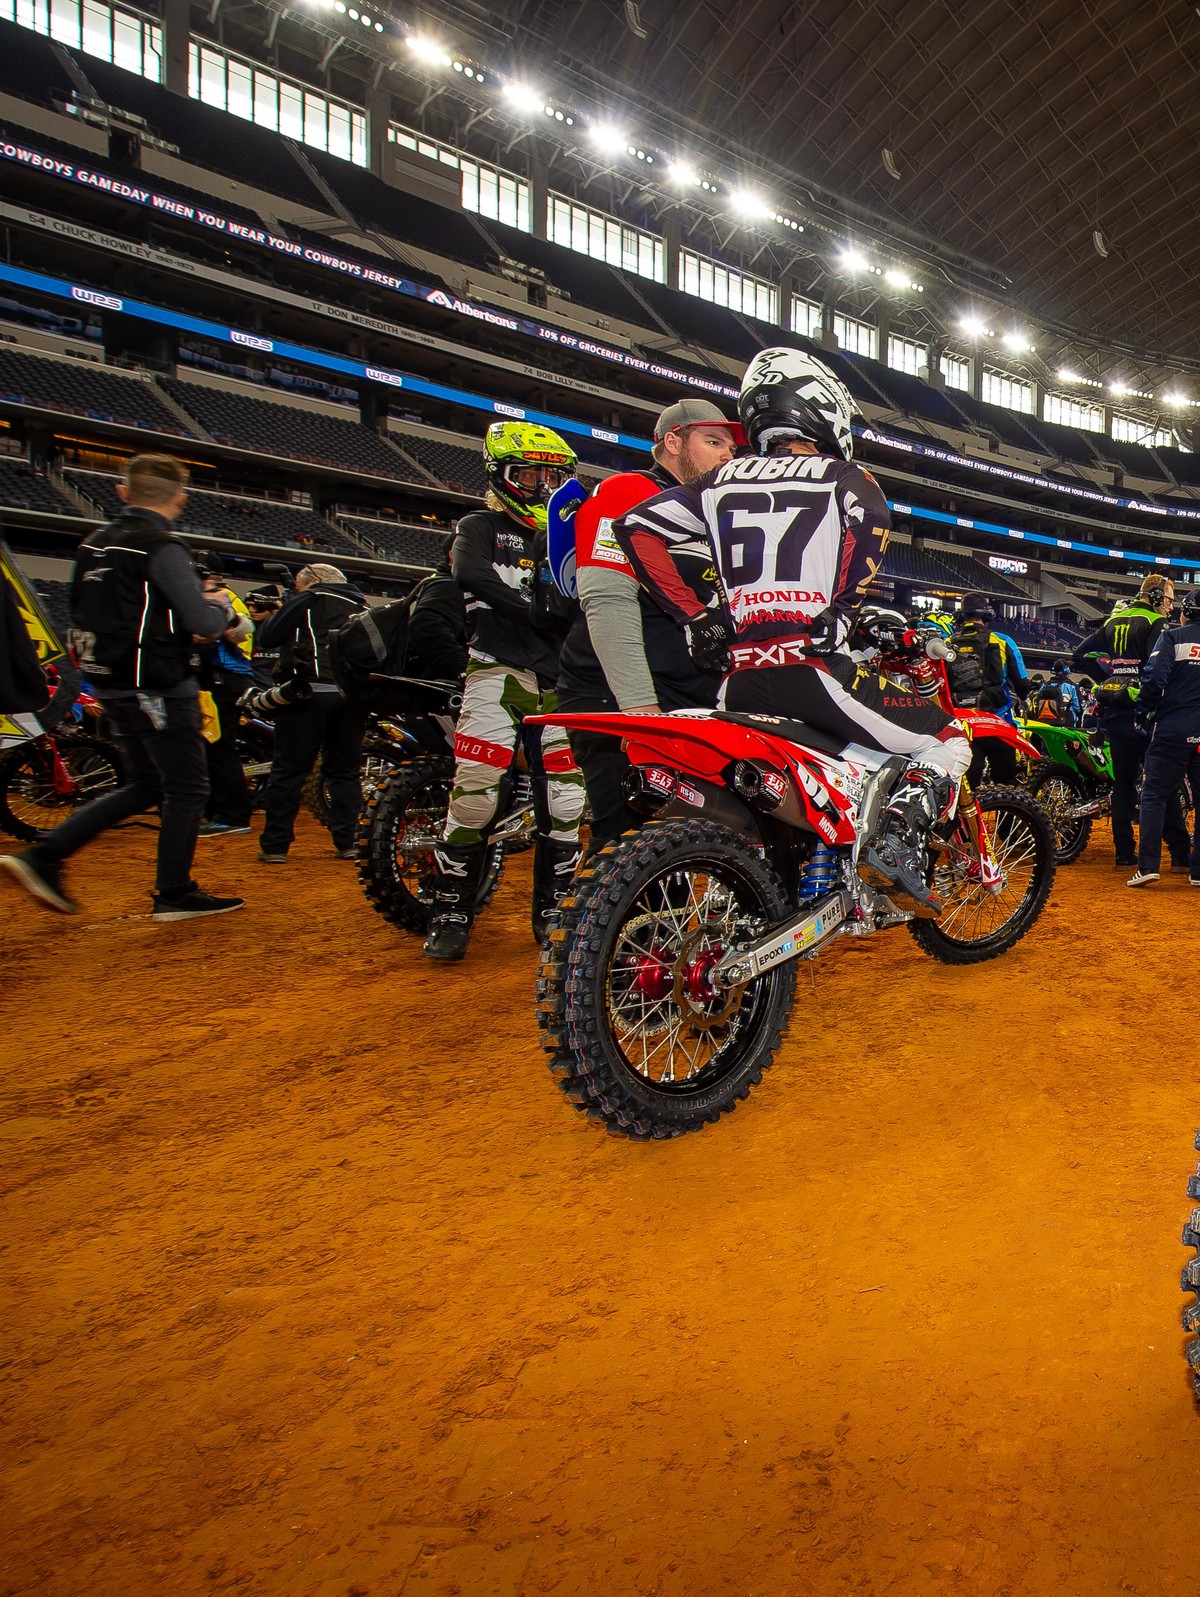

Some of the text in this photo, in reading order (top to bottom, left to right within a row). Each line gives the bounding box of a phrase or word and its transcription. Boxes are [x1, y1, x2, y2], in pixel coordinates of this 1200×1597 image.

[29, 213, 46, 226] 54
[53, 221, 97, 242] CHUCK
[100, 235, 152, 258] HOWLEY
[76, 170, 149, 202] GAMEDAY
[152, 195, 195, 219] WHEN
[198, 210, 226, 230] YOU
[228, 221, 266, 244] WEAR
[268, 235, 302, 257] YOUR
[304, 249, 361, 276] COWBOYS
[361, 268, 402, 289] JERSEY
[312, 302, 322, 310] 17
[327, 307, 348, 320] DON
[351, 314, 399, 335] MEREDITH
[452, 300, 518, 330] Albertsons
[539, 327, 558, 341] 10%
[560, 334, 577, 348] OFF
[578, 341, 624, 363] GROCERIES
[624, 355, 650, 371] EVERY
[650, 364, 687, 383] COWBOYS
[688, 376, 723, 393] GAMEDAY
[523, 366, 533, 375] 74
[537, 371, 553, 381] BOB
[554, 374, 574, 387] LILLY
[876, 435, 913, 452] Albertsons
[714, 456, 836, 485] ROBIN
[924, 448, 1119, 505] 10% OFF GROCERIES EVERY COWBOYS GAMEDAY WHEN YOU WEAR YOUR COWBOYS JERSEY
[1187, 511, 1196, 519] OFF
[716, 490, 833, 585] 67
[596, 549, 626, 563] MOTUL
[988, 555, 1028, 575] STACYC
[743, 590, 827, 606] HONDA
[732, 639, 806, 668] FXR
[1113, 666, 1139, 675] wasaki
[883, 696, 914, 708] FACE
[455, 740, 496, 759] THOR
[650, 770, 673, 789] ヨシムラ
[766, 774, 785, 793] ヨシムラ
[818, 816, 840, 844] MOTUL
[821, 903, 841, 925] PURE
